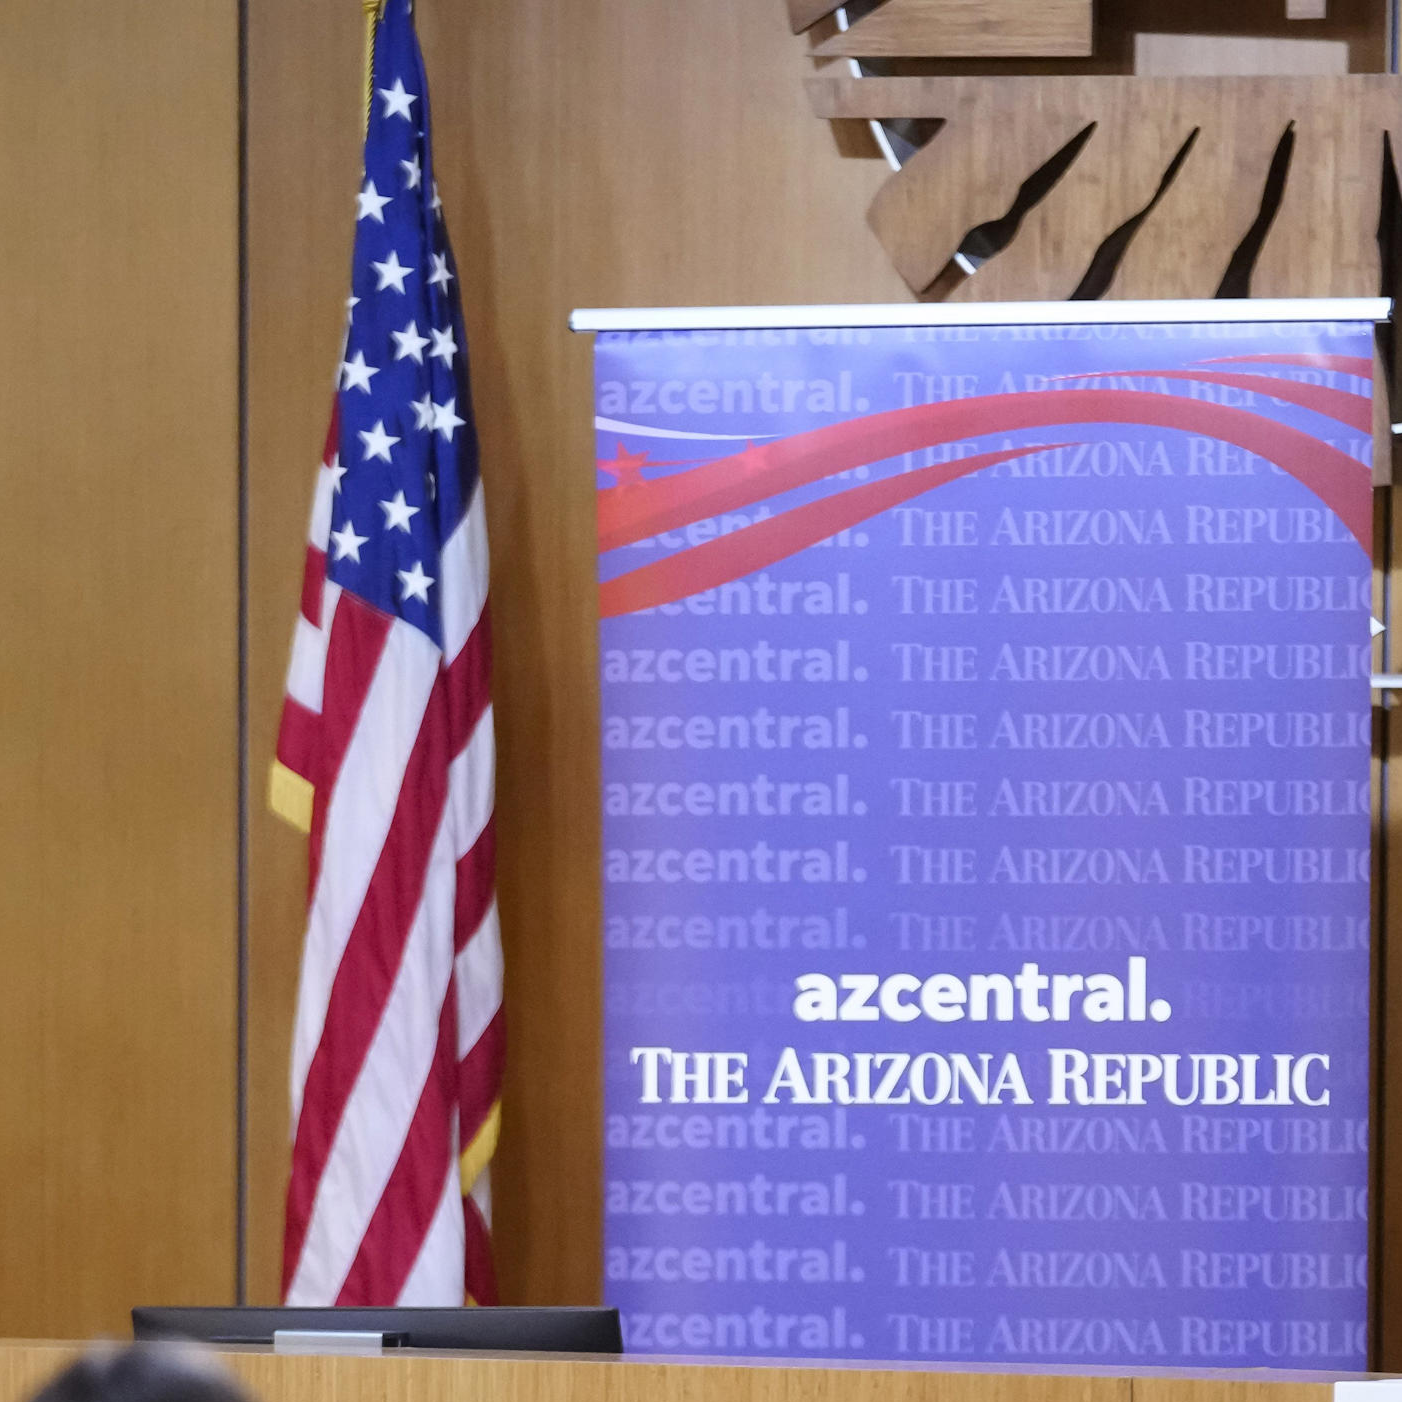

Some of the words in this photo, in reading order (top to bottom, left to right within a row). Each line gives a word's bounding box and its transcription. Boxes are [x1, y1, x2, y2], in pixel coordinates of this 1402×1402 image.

[600, 370, 870, 415] azcentral.
[891, 507, 978, 548] THE
[990, 507, 1172, 548] ARIZONA
[1185, 504, 1357, 545] REPUBL
[636, 571, 868, 616] entral.
[891, 574, 978, 615] THE
[990, 574, 1172, 615] ARIZONA
[604, 637, 868, 682] azcentral.
[891, 641, 977, 682] THE
[990, 641, 1171, 682] ARIZONA
[604, 704, 868, 749] azcentral.
[890, 708, 977, 749] THE
[989, 708, 1170, 749] ARIZONA
[605, 771, 868, 816] azcentral.
[890, 775, 977, 816] THE
[989, 776, 1170, 817] ARIZONA
[606, 838, 867, 883] azcentral.
[890, 842, 976, 883] THE
[989, 843, 1170, 884] ARIZONA
[793, 954, 1173, 1024] azcentral.
[628, 1045, 750, 1106] THE
[760, 1046, 1035, 1106] ARIZONA
[1045, 1047, 1332, 1108] REPUBLIC
[607, 1105, 866, 1150] azcentral.
[888, 1111, 975, 1152] THE
[987, 1112, 1168, 1153] ARIZONA
[607, 1172, 865, 1217] azcentral.
[888, 1178, 974, 1219] THE
[987, 1179, 1167, 1220] ARIZONA
[607, 1238, 865, 1283] azcentral.
[887, 1245, 974, 1286] THE
[986, 1246, 1166, 1287] ARIZONA
[620, 1305, 865, 1350] zcentral.
[887, 1312, 973, 1353] THE
[986, 1313, 1166, 1354] ARIZONA
